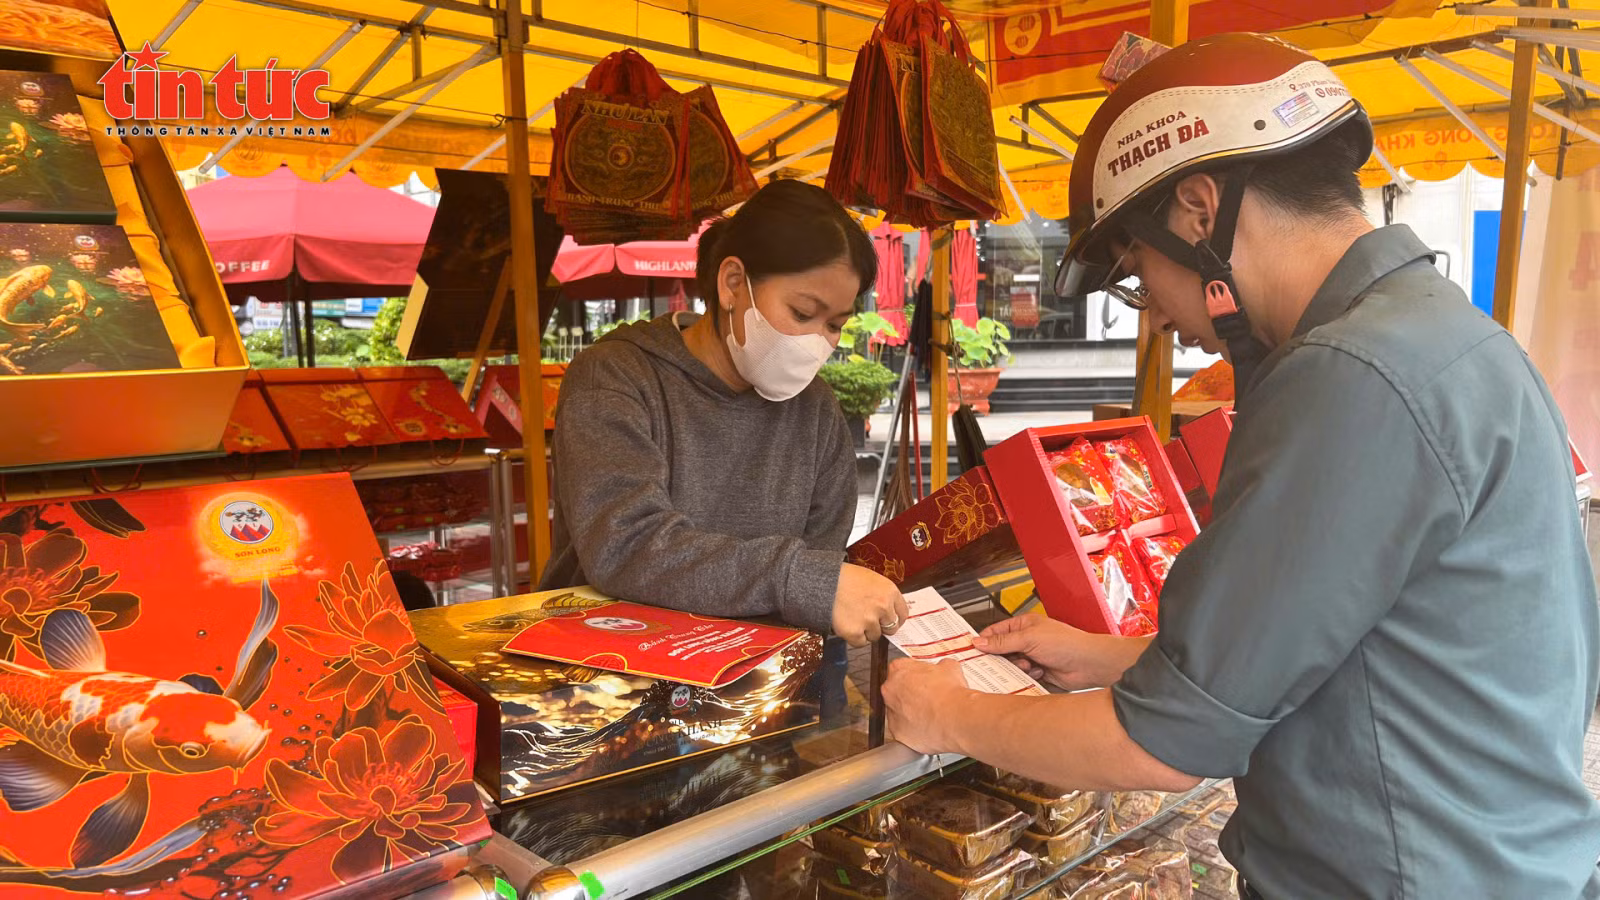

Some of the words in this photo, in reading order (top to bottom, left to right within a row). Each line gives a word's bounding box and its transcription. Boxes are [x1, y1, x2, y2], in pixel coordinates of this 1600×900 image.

[1107, 132, 1171, 177] THẠCH
[1177, 116, 1210, 144] ĐÀ
[1117, 129, 1143, 149] NHA
[1146, 110, 1187, 134] KHOA
[215, 259, 271, 273] OFFEE
